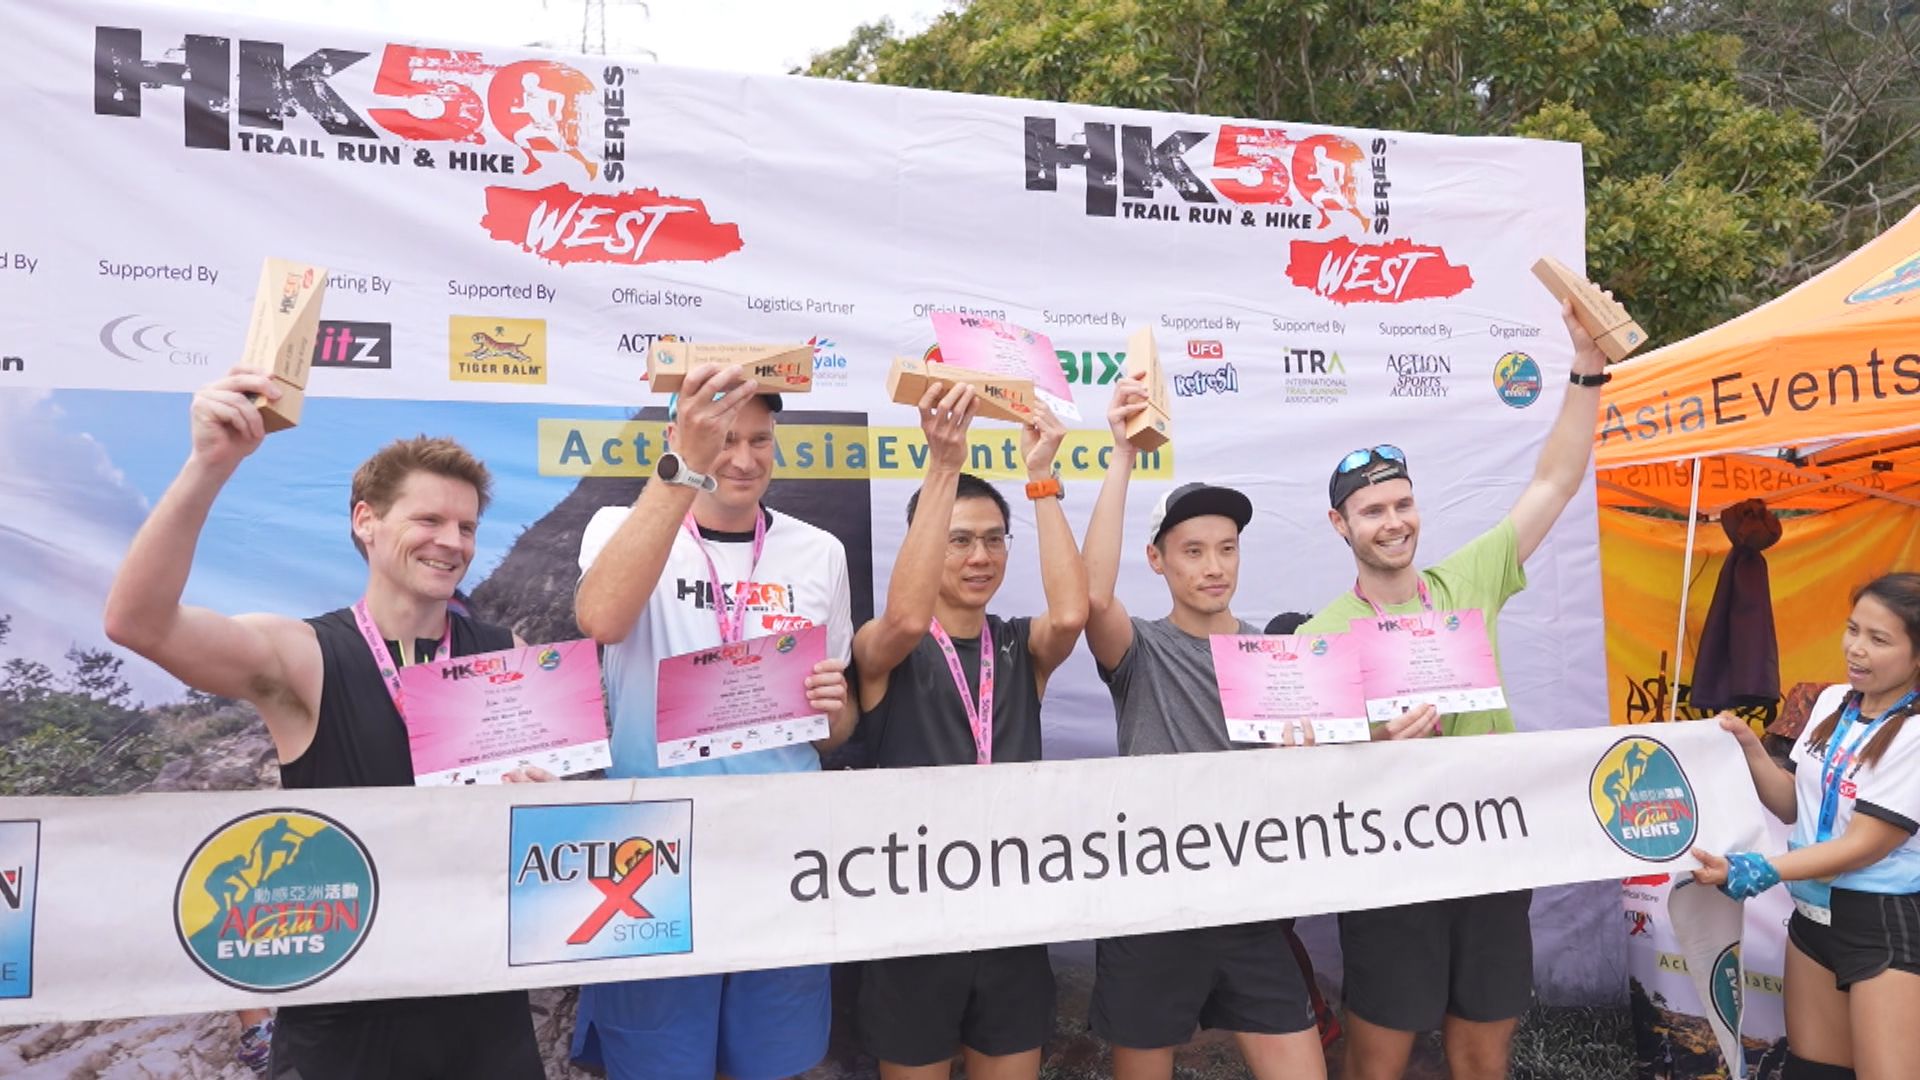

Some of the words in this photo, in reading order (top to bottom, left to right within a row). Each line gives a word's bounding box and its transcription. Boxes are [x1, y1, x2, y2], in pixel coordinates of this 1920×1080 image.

[94, 26, 597, 152] HK50
[603, 65, 625, 183] SERIES
[238, 133, 324, 160] TRAIL
[338, 143, 402, 165] RUN
[413, 147, 435, 169] &
[448, 151, 515, 174] HIKE
[1024, 116, 1366, 217] HK50
[1372, 137, 1390, 235] SERIES
[1122, 202, 1180, 222] TRAIL
[1189, 208, 1232, 225] RUN
[1241, 210, 1256, 227] &
[1266, 212, 1312, 230] HIKE
[527, 200, 699, 261] WEST
[14, 254, 38, 274] By
[99, 260, 192, 280] Supported
[197, 266, 218, 285] By
[1317, 250, 1438, 300] WEST
[372, 276, 391, 295] By
[449, 280, 532, 300] Supported
[537, 284, 556, 303] By
[612, 287, 661, 306] Official
[664, 290, 702, 307] Store
[747, 296, 802, 313] Logistics
[806, 298, 855, 315] Partner
[1043, 310, 1108, 326] Supported
[1111, 312, 1126, 329] By
[1161, 314, 1223, 331] Supported
[1226, 317, 1240, 331] By
[1273, 319, 1329, 333] Supported
[1333, 320, 1346, 334] By
[1379, 322, 1436, 336] Supported
[1439, 325, 1452, 338] By
[1490, 324, 1541, 338] Organizer
[316, 327, 381, 364] itz
[1190, 344, 1221, 355] UFC
[458, 362, 497, 374] TIGER
[503, 364, 540, 375] BALM
[814, 353, 847, 369] yale
[1387, 353, 1450, 374] ACTION
[1389, 387, 1449, 398] ACADEMY
[1397, 376, 1441, 387] SPORTS
[1601, 347, 1920, 447] AsiaEvents
[1621, 821, 1680, 839] EVENTS
[517, 836, 681, 884] ACTION
[789, 795, 1530, 903] actionasiaevents.com
[219, 900, 360, 938] ACTION
[613, 920, 682, 942] STORE
[217, 934, 325, 960] EVENTS
